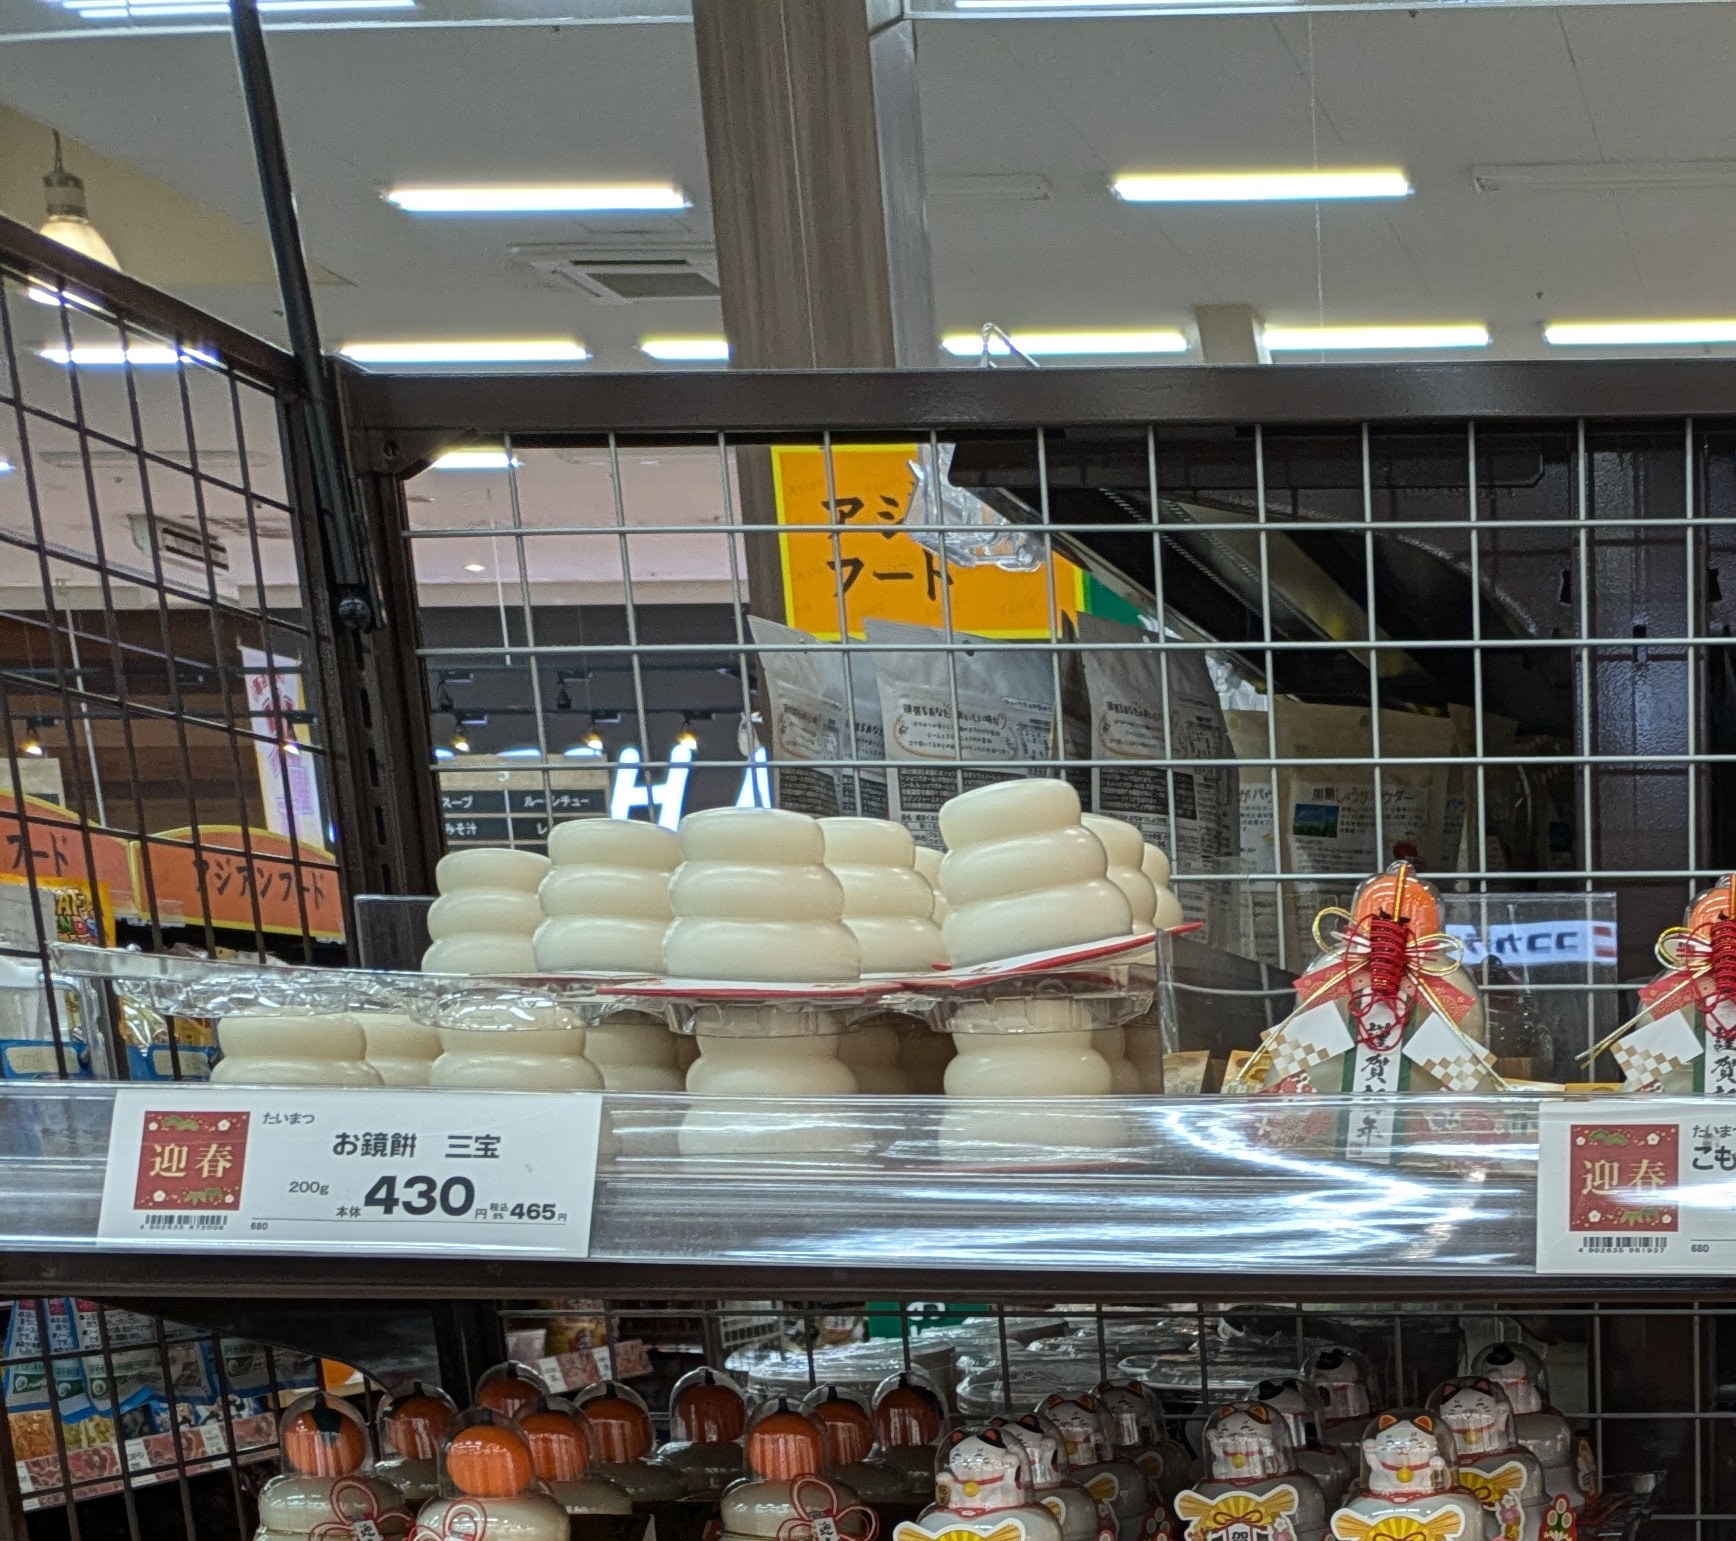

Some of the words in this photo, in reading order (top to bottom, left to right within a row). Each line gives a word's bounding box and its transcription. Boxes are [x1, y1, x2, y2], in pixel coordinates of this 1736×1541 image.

[262, 1112, 315, 1126] たいまつ
[149, 1143, 234, 1179] 迎春
[333, 1131, 417, 1158] お鏡餅
[444, 1134, 501, 1159] 三宝
[288, 1181, 329, 1196] 200g
[1581, 1159, 1666, 1196] 迎春
[363, 1175, 475, 1217] 430
